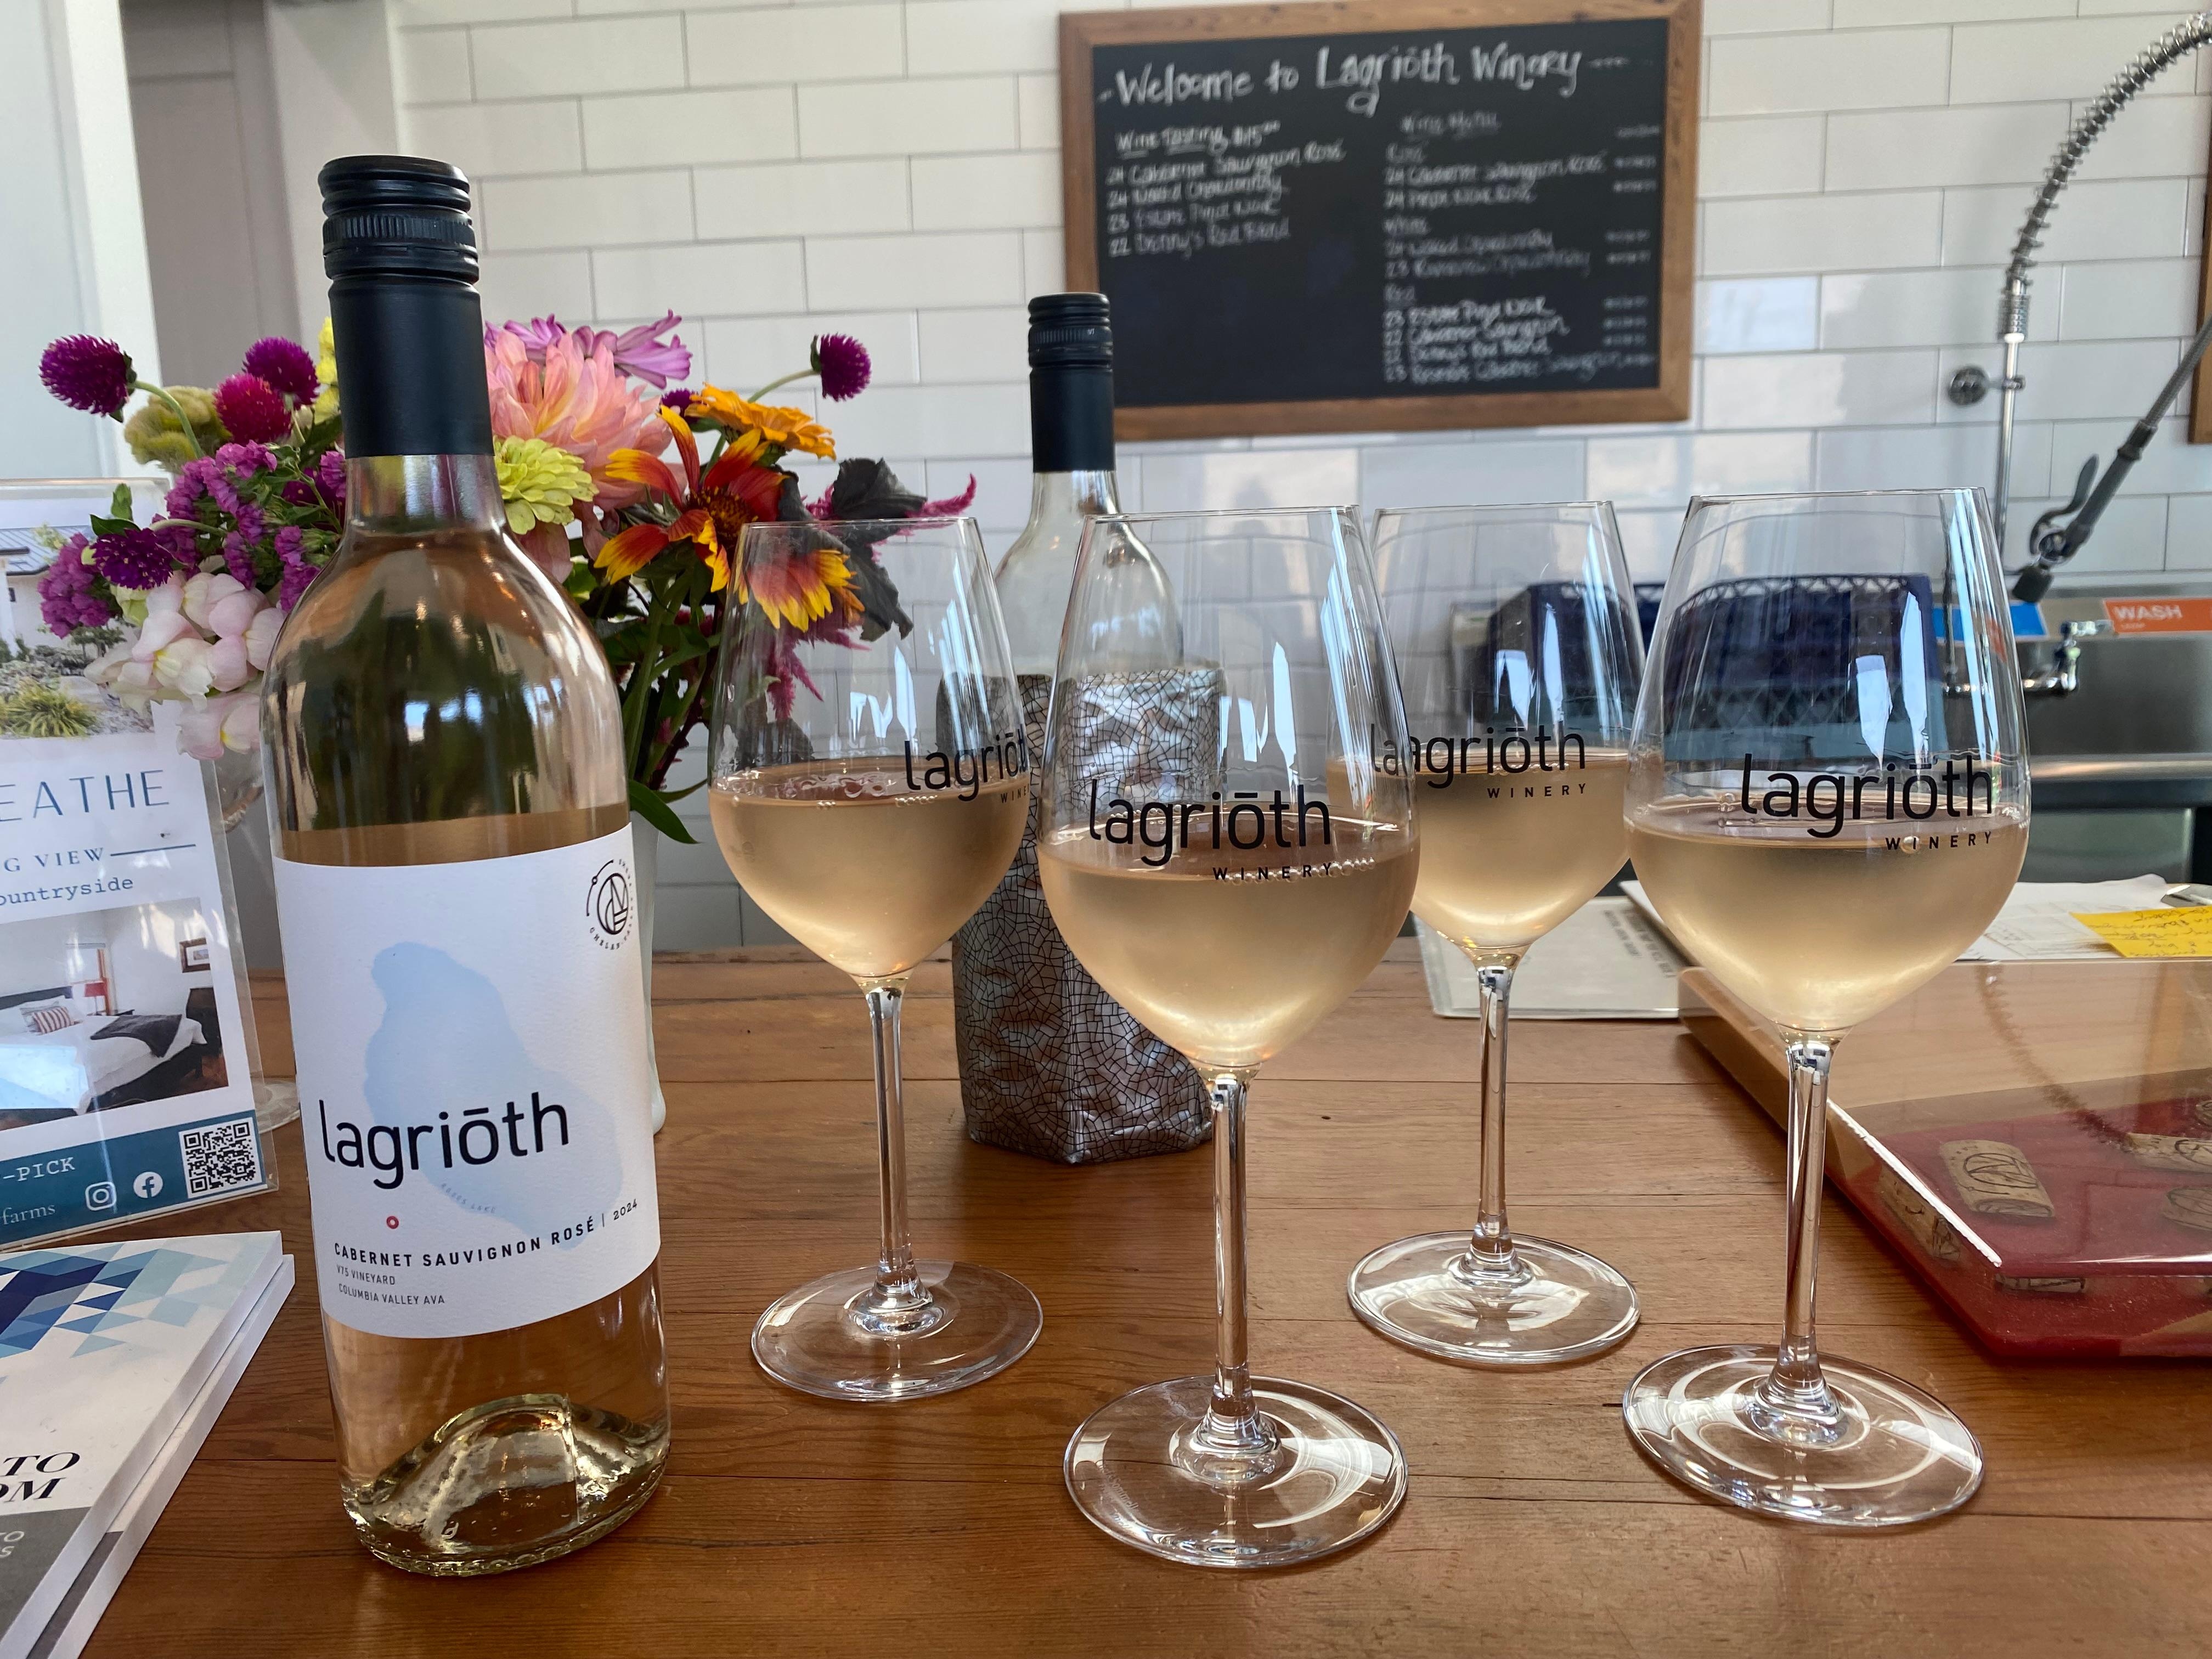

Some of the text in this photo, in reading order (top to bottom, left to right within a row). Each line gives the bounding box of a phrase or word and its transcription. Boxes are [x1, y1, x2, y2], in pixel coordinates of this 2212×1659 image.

[1115, 61, 1255, 108] Welcome
[1264, 58, 1300, 94] to
[1470, 41, 1583, 98] Winery
[2113, 605, 2183, 620] WASH
[1487, 783, 1586, 799] WINERY
[1886, 831, 1992, 851] WINERY
[34, 847, 104, 868] VIEW
[1213, 862, 1333, 881] WINERY
[1, 1204, 56, 1225] farms
[334, 1198, 637, 1267] CABERNET SAUVIGNON ROSÉ 2024
[351, 1269, 396, 1285] VINEYARD
[338, 1283, 445, 1305] COLUMBIA VALLEY AVA
[0, 1452, 81, 1477] TO
[0, 1530, 25, 1543] O
